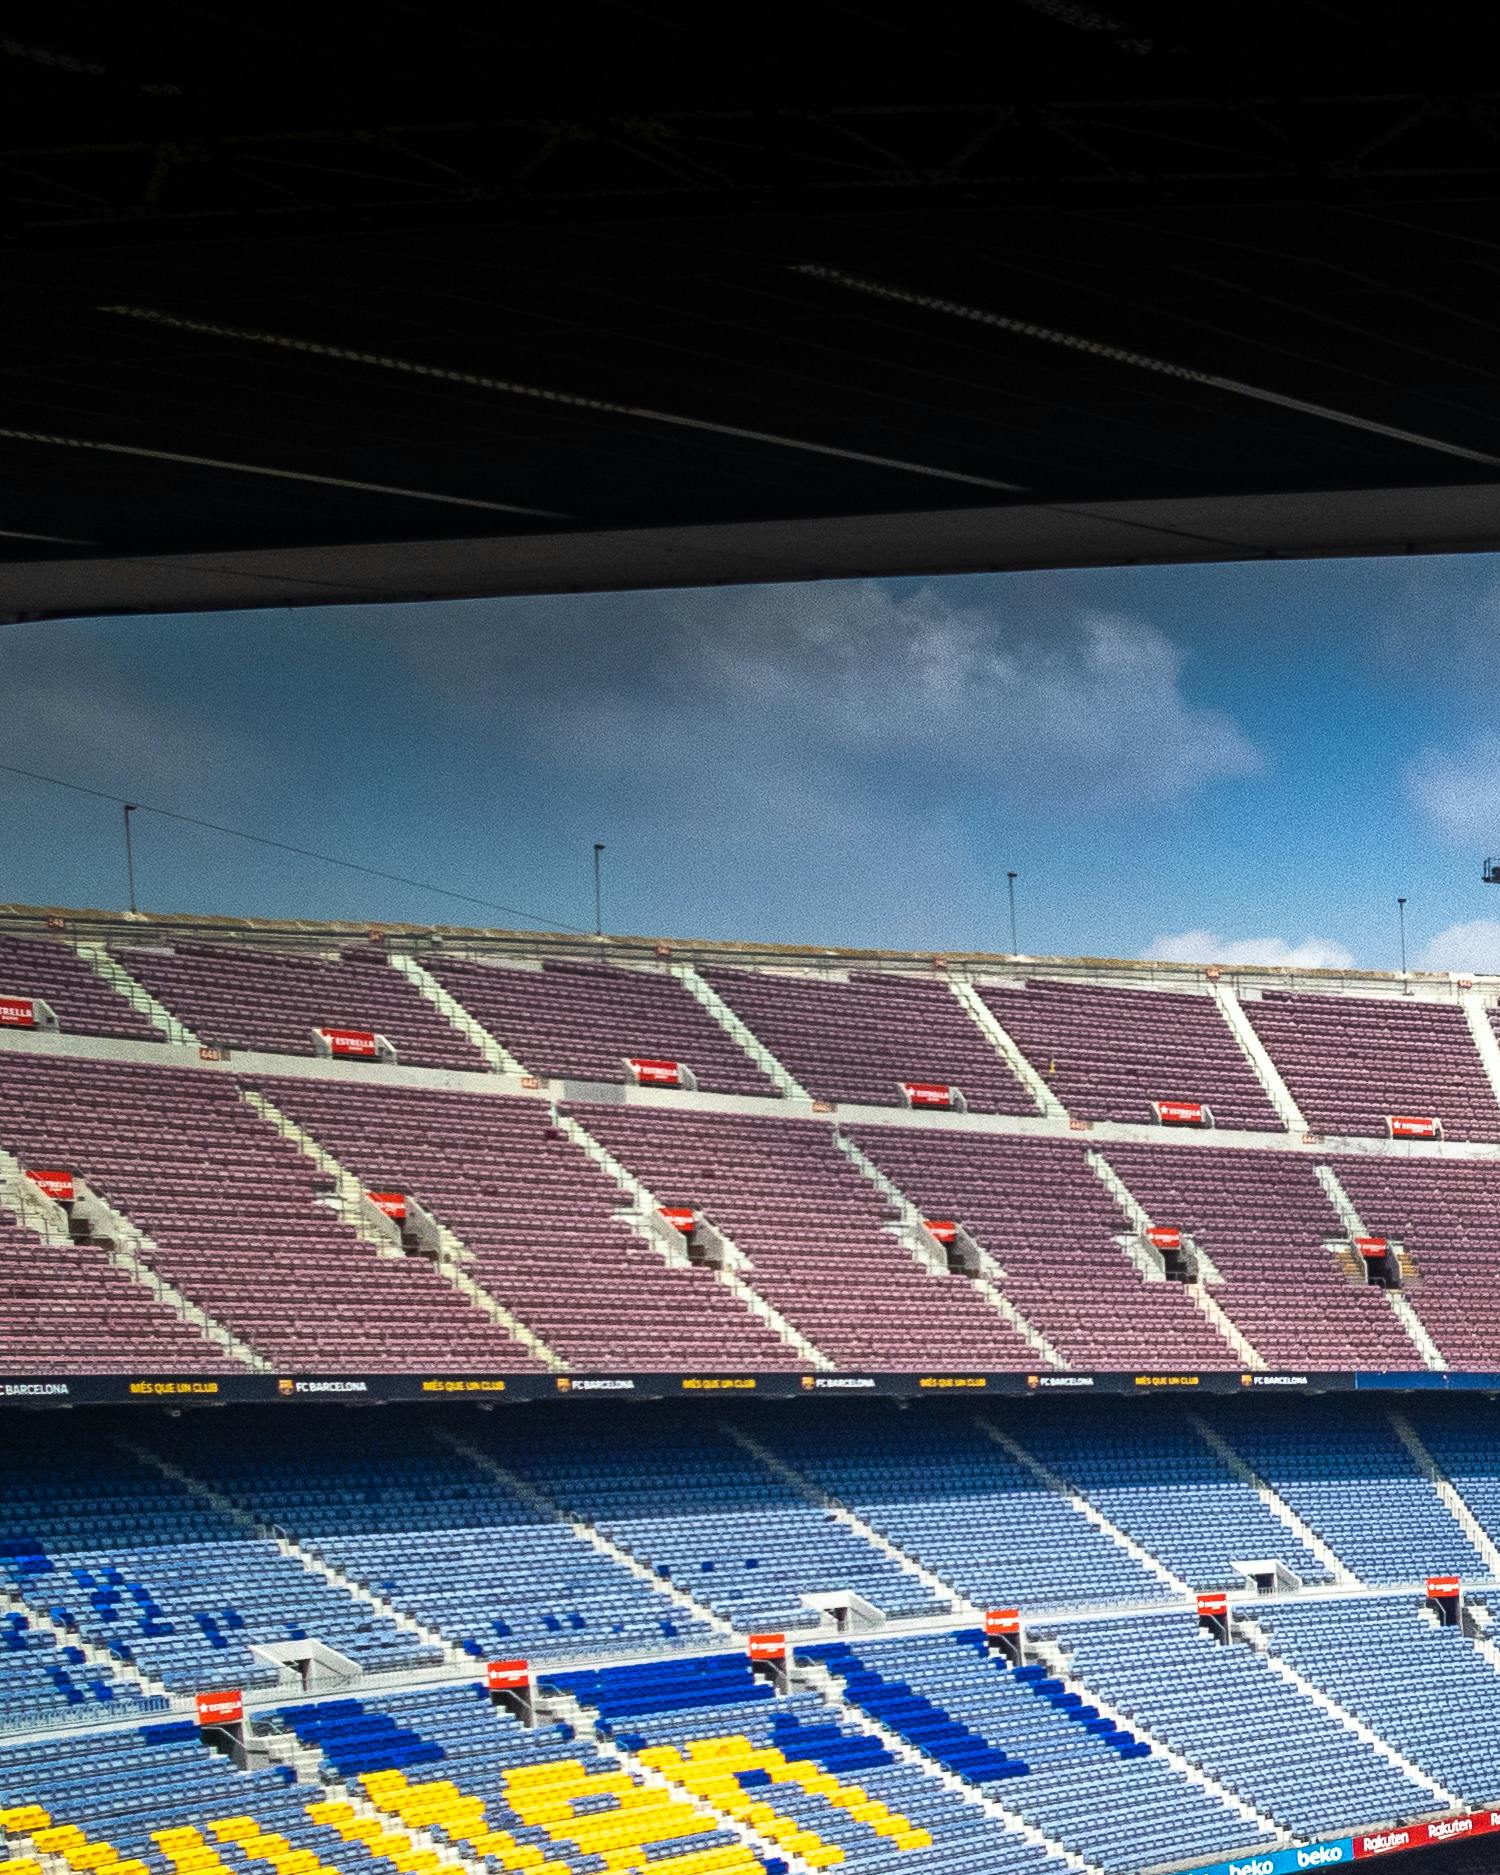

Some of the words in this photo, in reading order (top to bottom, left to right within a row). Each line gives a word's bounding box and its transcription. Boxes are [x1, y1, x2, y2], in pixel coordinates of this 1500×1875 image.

[1428, 1819, 1472, 1840] Rakuten
[1364, 1833, 1409, 1857] Rakuten
[1298, 1847, 1342, 1867] beko
